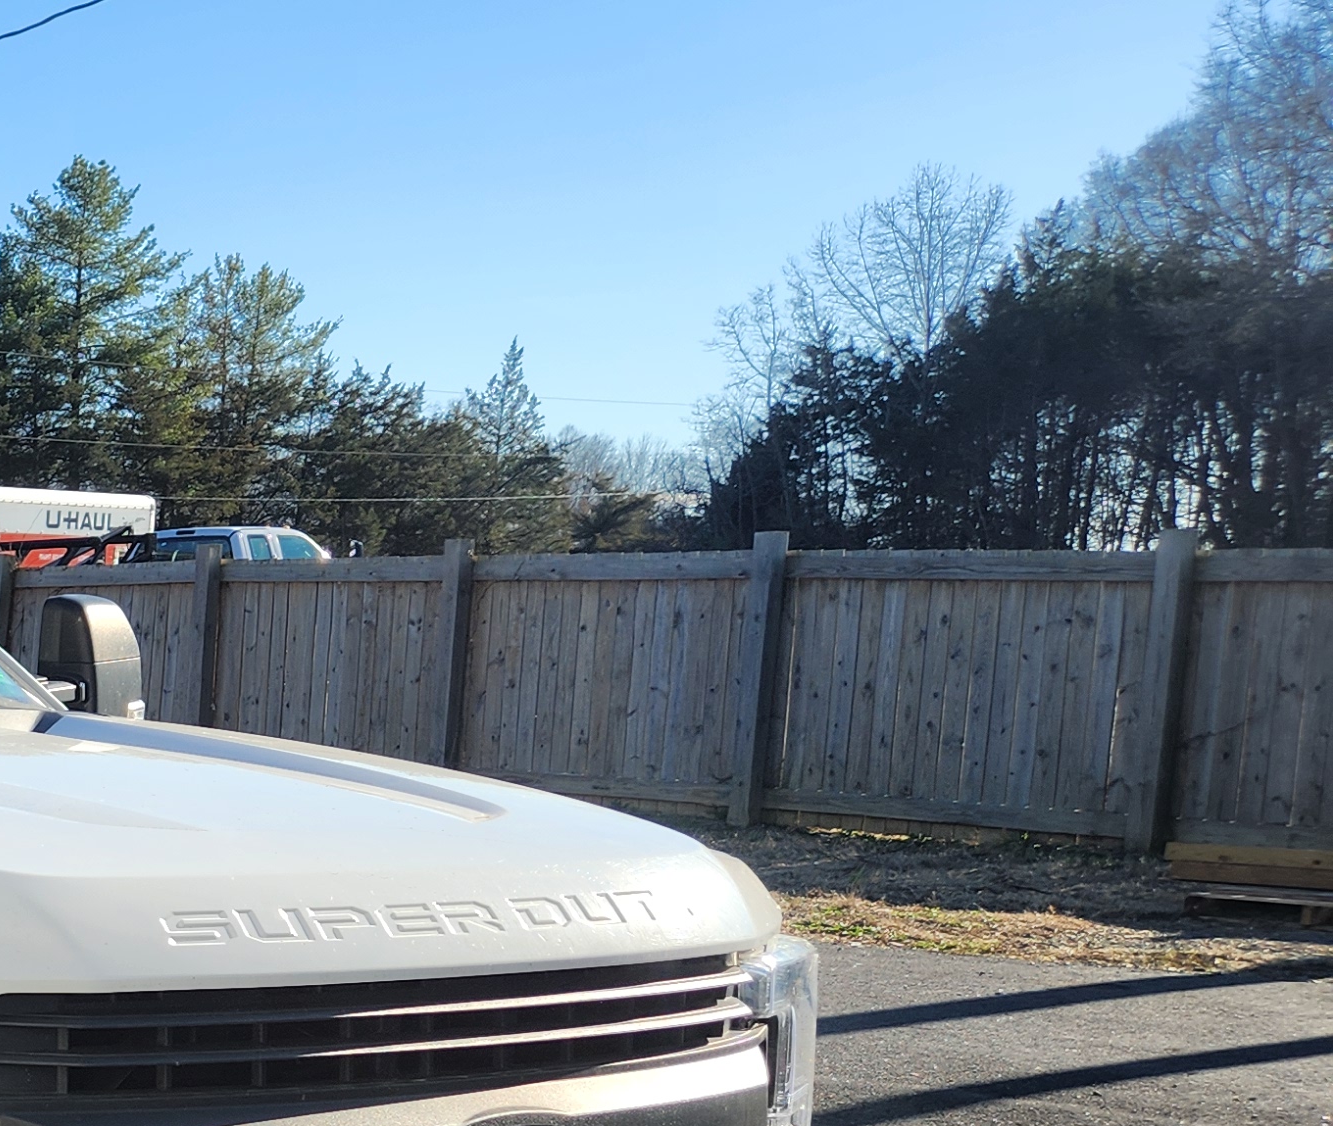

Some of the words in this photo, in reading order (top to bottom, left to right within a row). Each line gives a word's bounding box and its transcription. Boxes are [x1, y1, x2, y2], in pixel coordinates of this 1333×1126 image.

[46, 509, 116, 531] U-HAUL
[159, 900, 507, 946] SUPER
[505, 889, 694, 932] DUT
